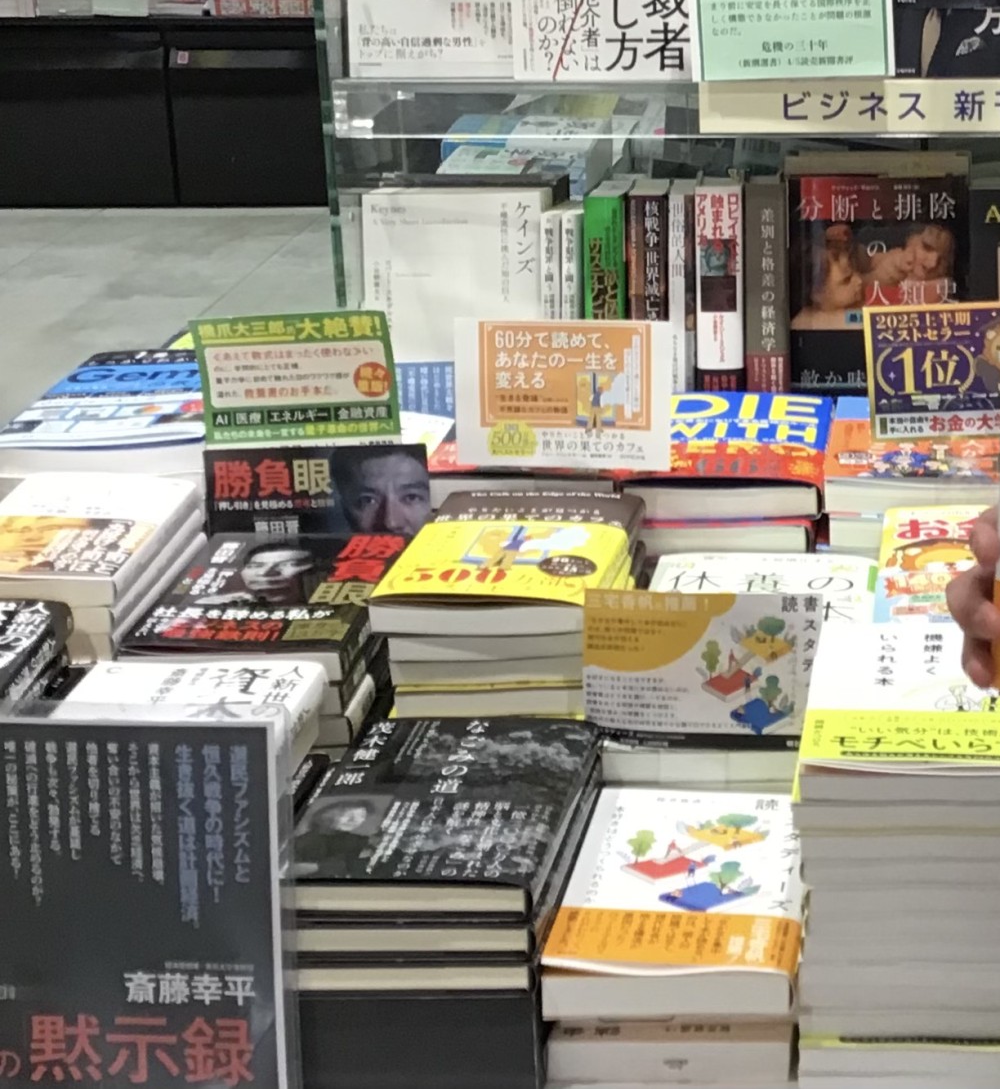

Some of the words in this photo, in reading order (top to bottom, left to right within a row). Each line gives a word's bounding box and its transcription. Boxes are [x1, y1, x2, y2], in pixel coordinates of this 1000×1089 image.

[762, 40, 828, 53] 危機の三十年
[783, 91, 926, 121] ビジネス
[797, 192, 957, 223] 分断と排除
[515, 201, 535, 274] ケインズ
[867, 241, 887, 257] の
[761, 208, 776, 352] 差別と格差の経済学
[876, 312, 971, 329] 2025上半期
[877, 329, 971, 342] ベストセラー
[495, 352, 617, 370] あなたの一生を
[892, 347, 960, 395] 1位
[495, 372, 545, 389] 変える
[215, 415, 229, 426] AI
[236, 412, 262, 425] 医療
[270, 410, 329, 422] エネルギー
[337, 407, 390, 421] 金融資産
[671, 394, 823, 424] DIE
[213, 459, 333, 498] 勝負眼
[309, 535, 405, 606] 勝負眼
[874, 633, 898, 687] いられる本
[923, 633, 943, 675] 機嫌よく
[431, 720, 490, 794] なごみの道
[124, 972, 256, 1006] 斎藤幸平
